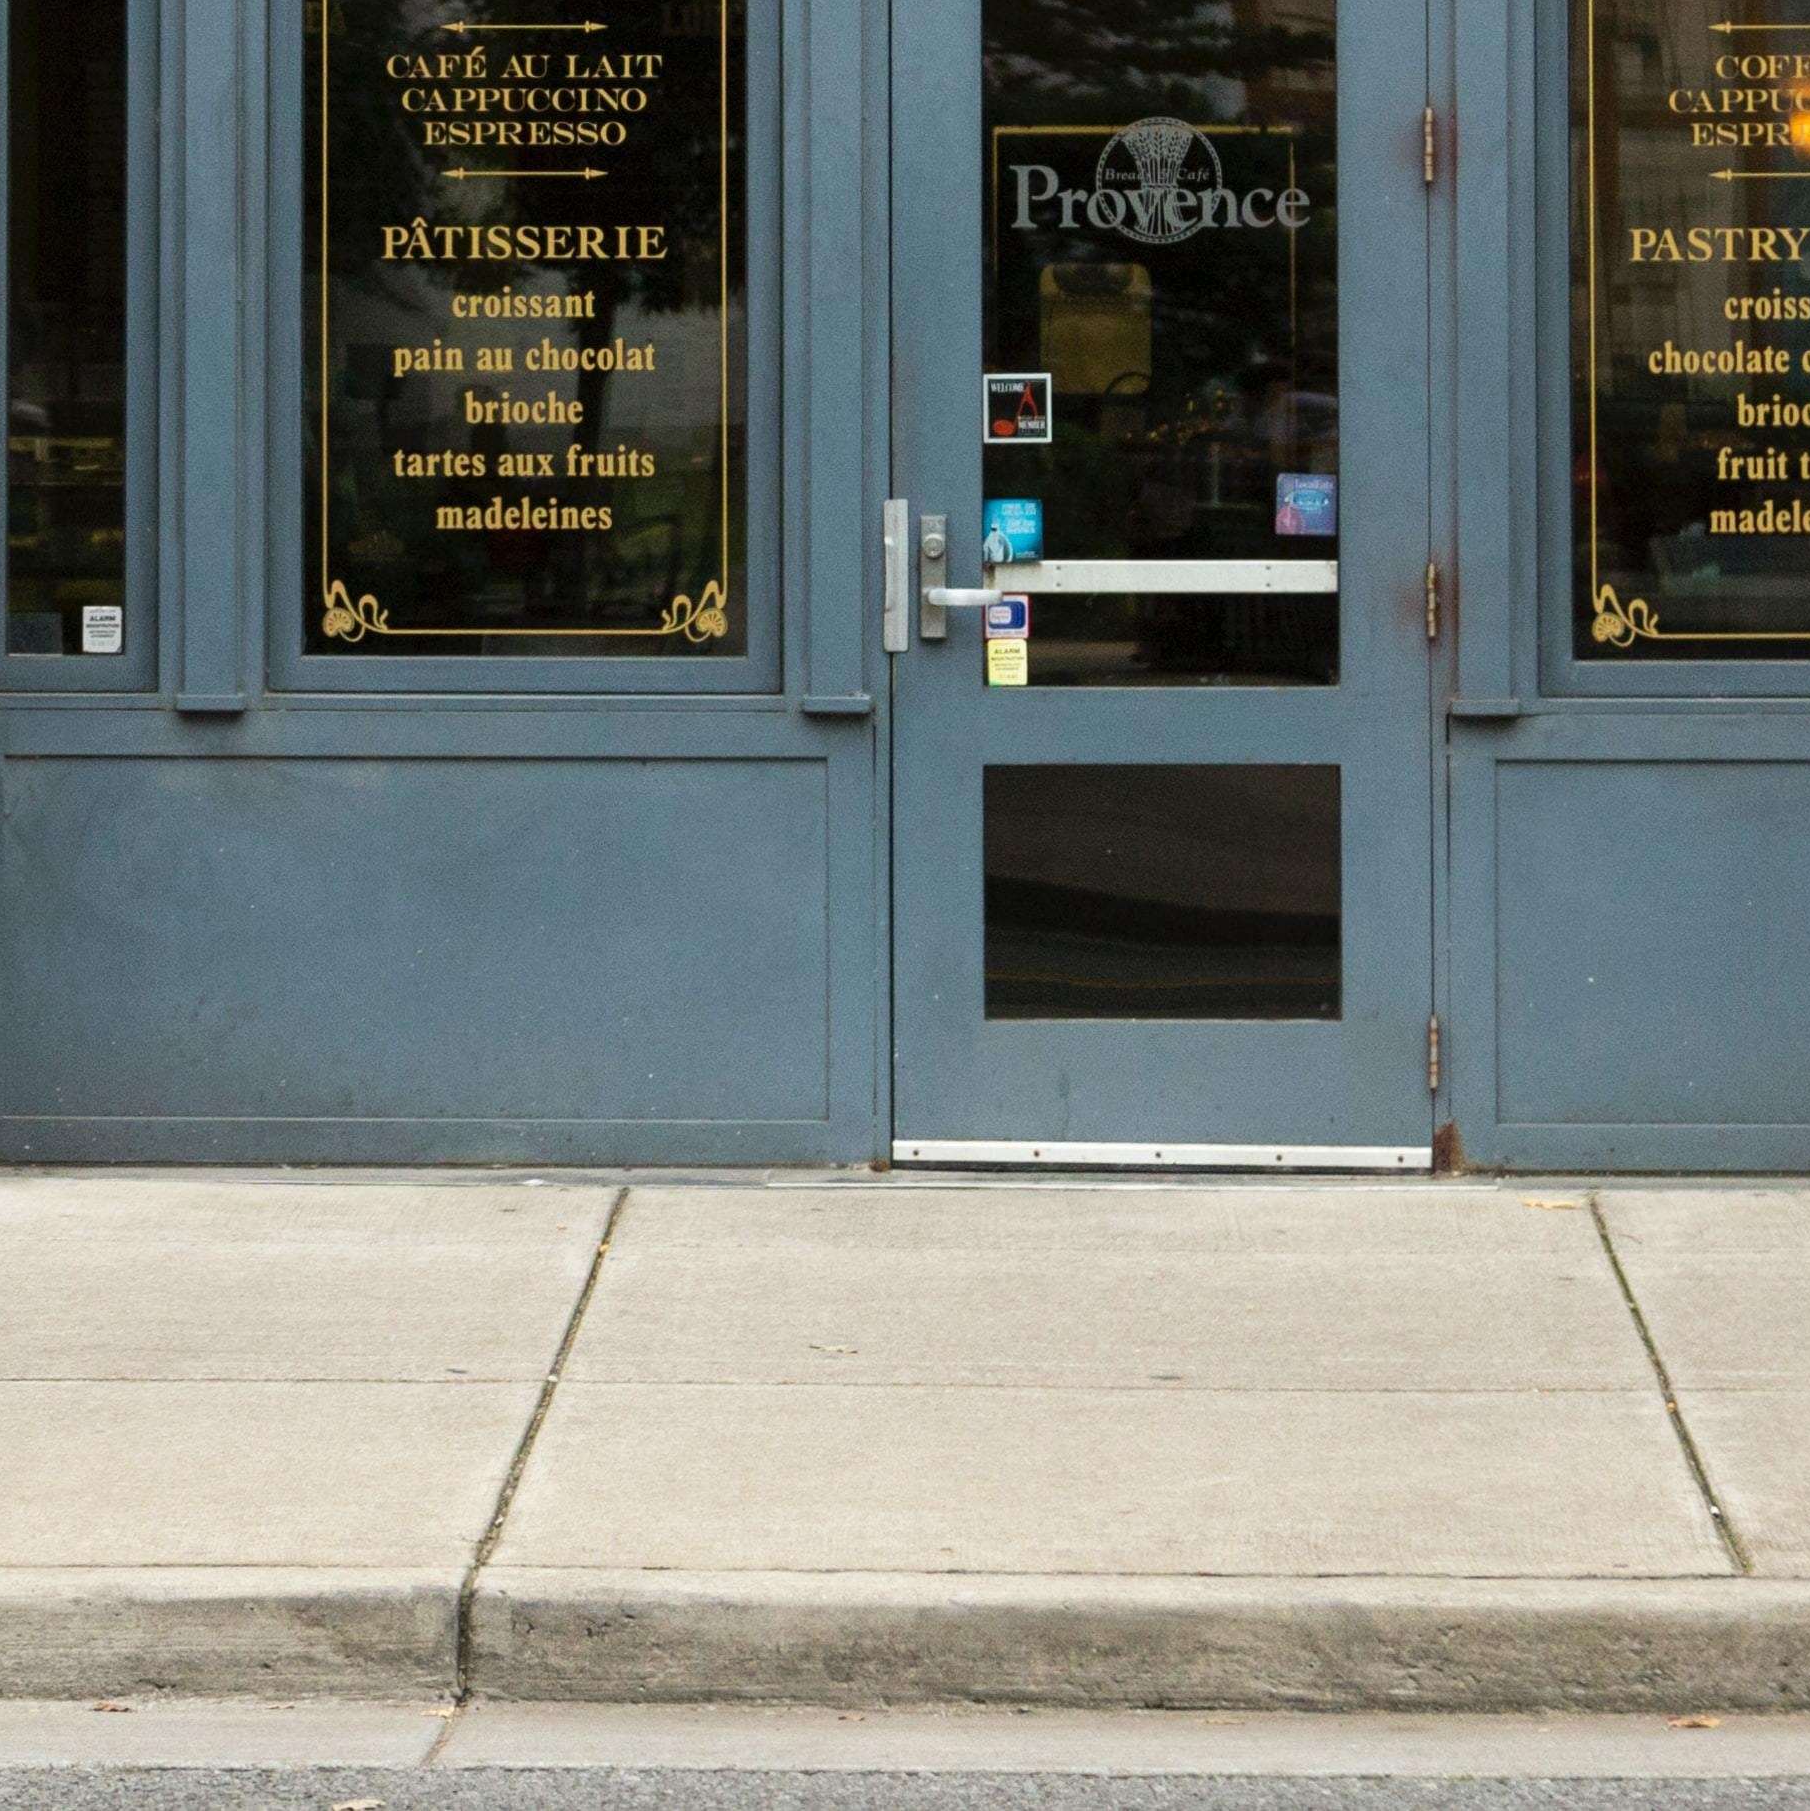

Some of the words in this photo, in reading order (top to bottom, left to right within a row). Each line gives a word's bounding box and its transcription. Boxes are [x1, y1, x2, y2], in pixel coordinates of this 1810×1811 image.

[385, 45, 487, 79] CAFÉ
[501, 54, 549, 79] AU
[565, 53, 664, 79] LAIT
[401, 87, 648, 113] CAPPUCCINO
[424, 121, 627, 146] ESPRESSO
[1176, 167, 1210, 183] Café
[1009, 164, 1311, 229] Provence
[382, 216, 666, 261] PÂTISSERIE
[1629, 226, 1810, 262] PASTRY
[451, 285, 595, 319] croissant
[393, 338, 464, 378] pain
[476, 348, 514, 373] au
[525, 337, 655, 372] chocolat
[1648, 339, 1790, 375] chocolate
[464, 390, 583, 425] brioche
[393, 449, 486, 478] tartes
[497, 453, 554, 477] aux
[566, 443, 656, 478] fruits
[1717, 446, 1788, 480] fruit
[436, 496, 613, 531] madeleines
